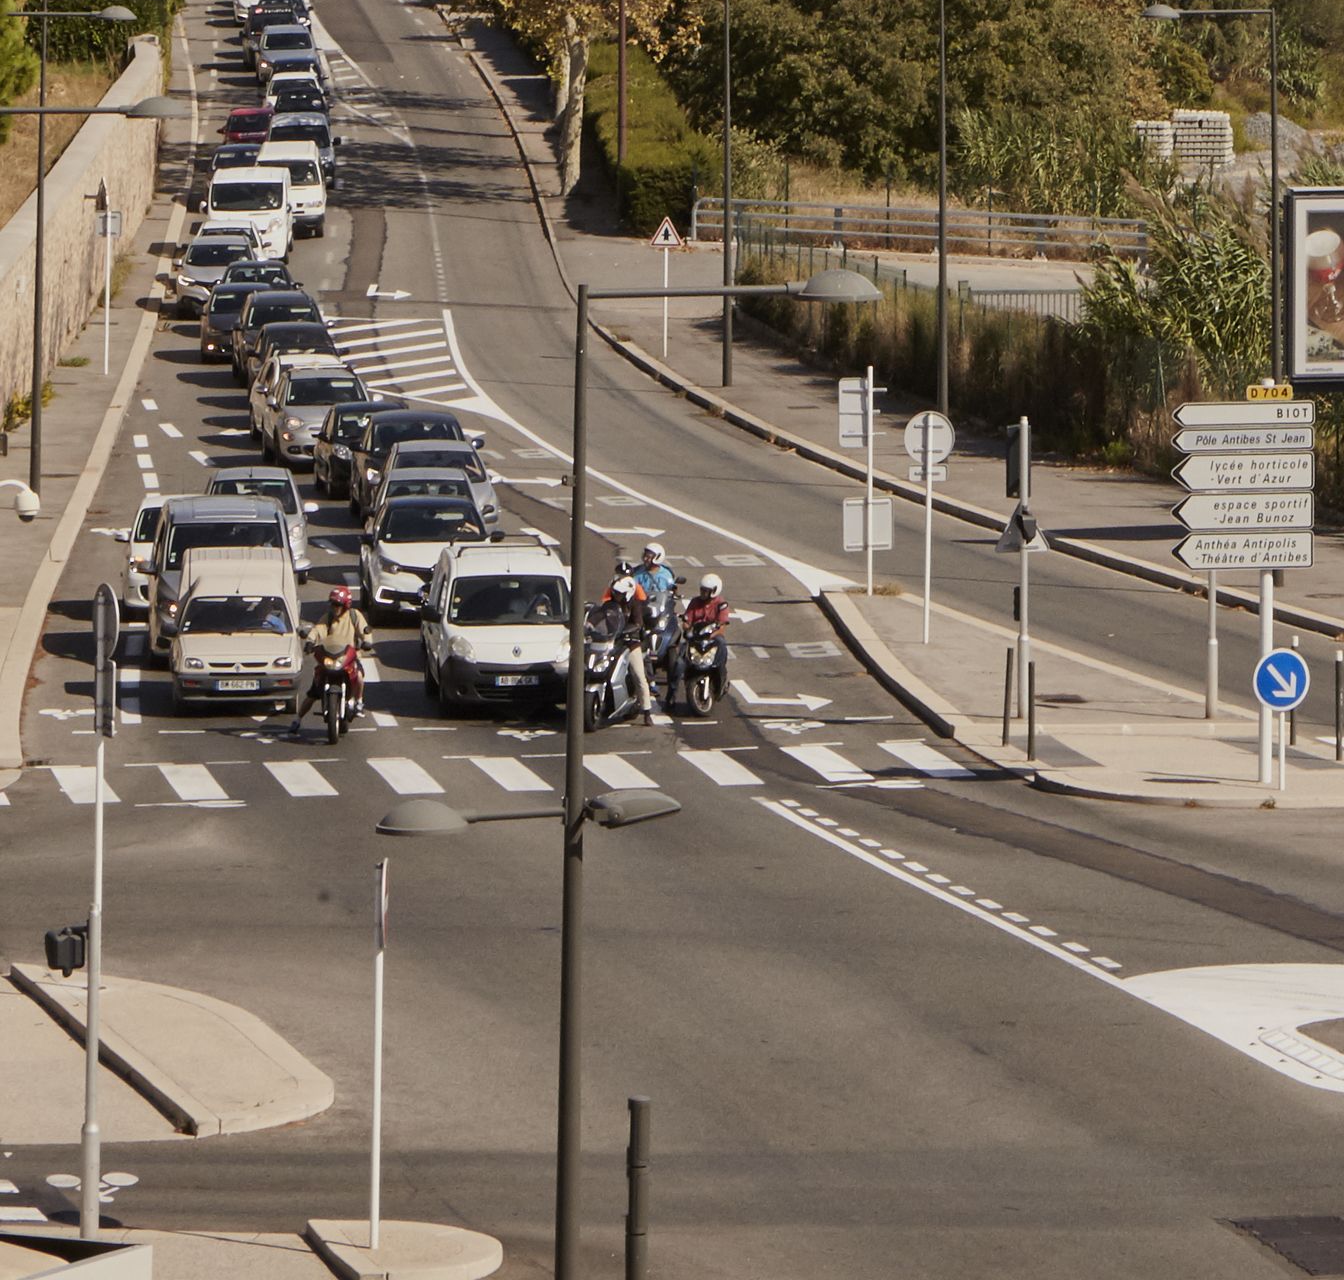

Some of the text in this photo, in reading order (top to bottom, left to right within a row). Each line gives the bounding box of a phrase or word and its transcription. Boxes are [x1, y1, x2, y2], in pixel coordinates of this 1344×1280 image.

[1251, 388, 1288, 398] D 704
[1276, 408, 1308, 418] BIOT
[1195, 433, 1305, 446] Pôle Antibes St Jean
[1210, 460, 1308, 471] lycée horticole
[1249, 474, 1292, 484] d'Azur
[1213, 498, 1309, 511] espace sportif
[1256, 513, 1295, 523] Bunoz
[1195, 538, 1297, 550] Anthéa Antipolis
[1250, 552, 1308, 562] d'Antibes
